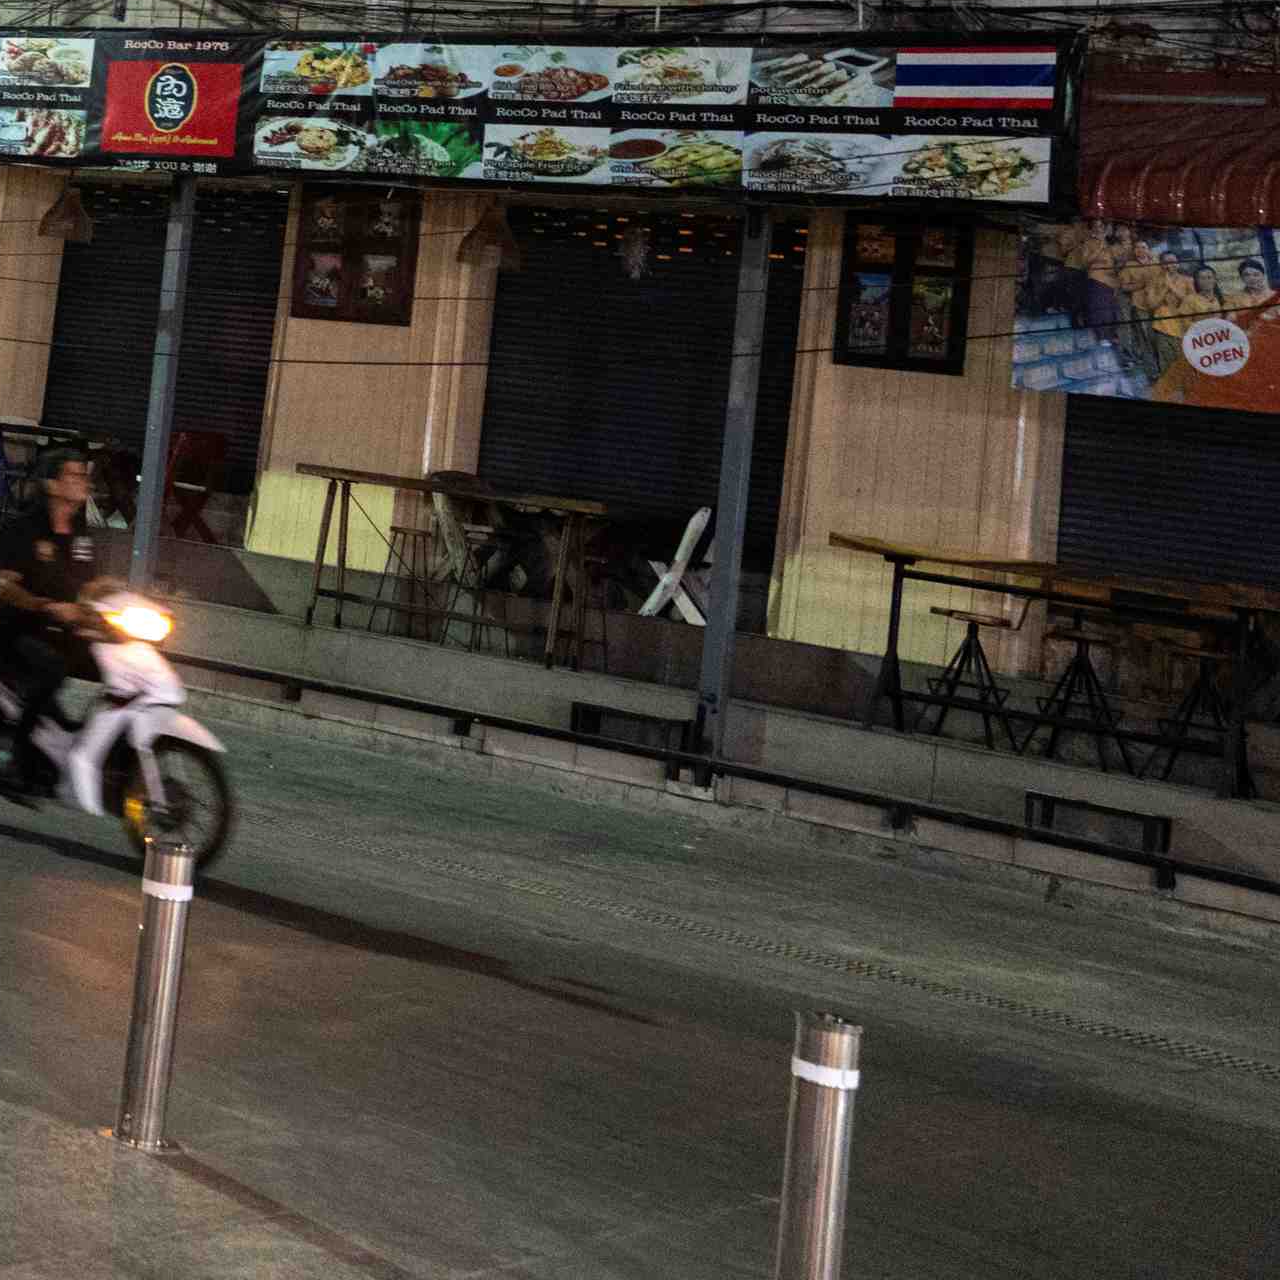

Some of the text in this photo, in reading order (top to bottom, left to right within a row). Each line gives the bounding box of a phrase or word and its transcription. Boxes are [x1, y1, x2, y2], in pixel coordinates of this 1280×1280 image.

[167, 40, 192, 50] Bar
[307, 100, 330, 111] Pad
[333, 101, 361, 112] Thai
[420, 104, 444, 115] Pad
[448, 105, 478, 116] Thai
[542, 108, 567, 119] Pad
[570, 109, 602, 120] Thai
[670, 111, 696, 122] Pad
[700, 112, 734, 123] Thai
[809, 114, 839, 125] Pad
[843, 115, 880, 126] Thai
[961, 117, 993, 128] Pad
[998, 117, 1039, 129] Thai
[154, 161, 178, 171] YOU
[180, 162, 190, 170] &
[1191, 328, 1231, 350] NOW
[1200, 346, 1244, 369] OPEN
